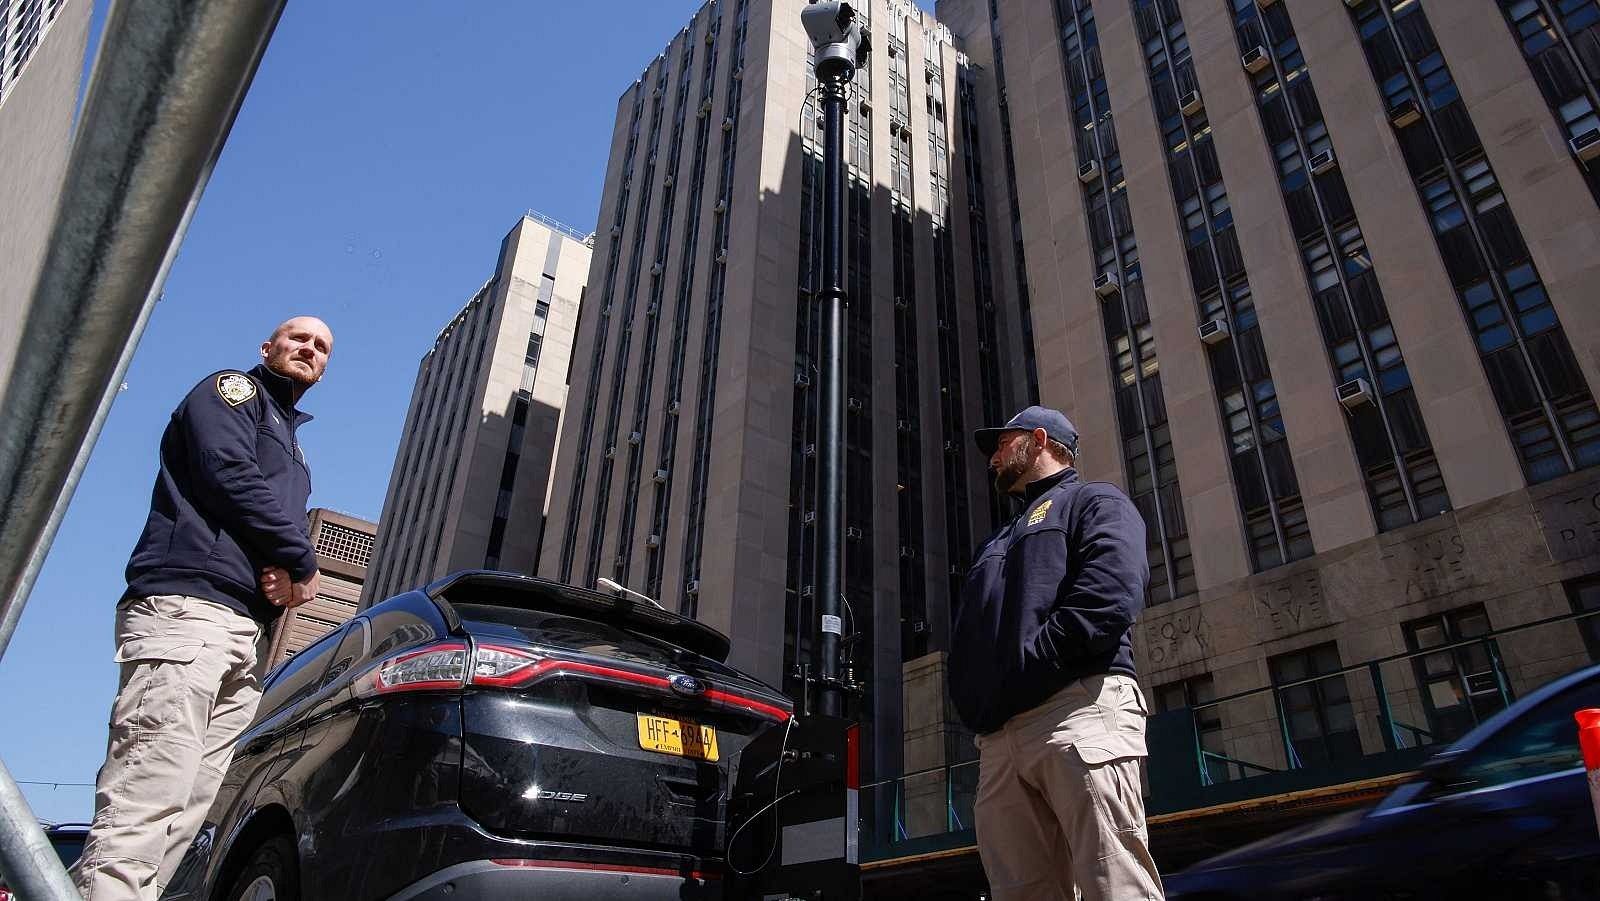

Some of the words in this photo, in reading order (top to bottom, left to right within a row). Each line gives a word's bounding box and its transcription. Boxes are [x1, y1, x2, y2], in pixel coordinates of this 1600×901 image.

[647, 717, 669, 742] HFF
[681, 726, 710, 752] 6944
[521, 787, 588, 802] DGE
